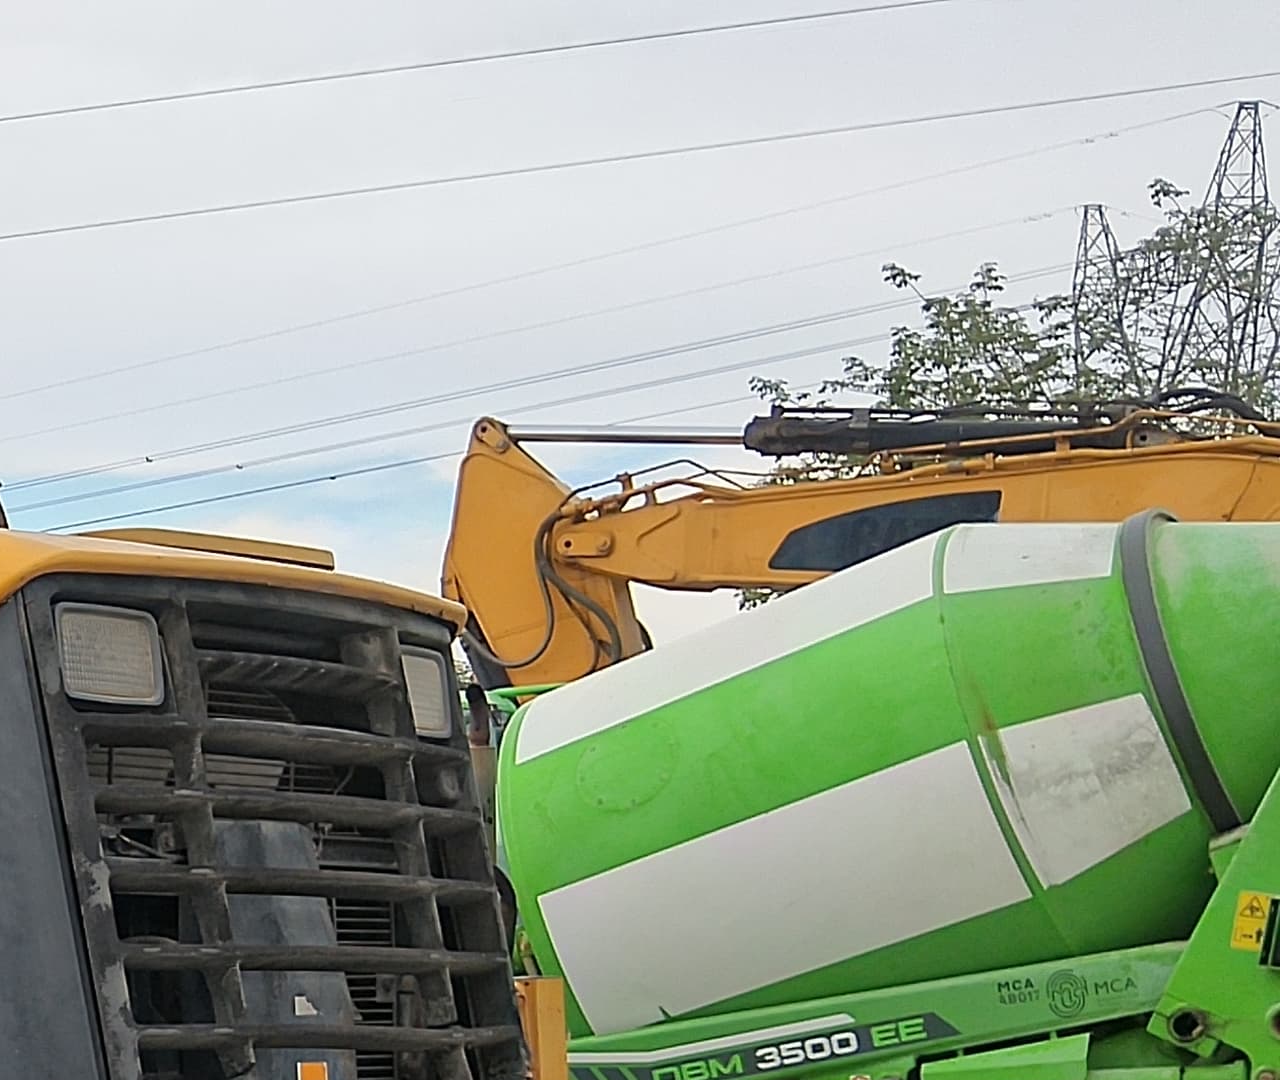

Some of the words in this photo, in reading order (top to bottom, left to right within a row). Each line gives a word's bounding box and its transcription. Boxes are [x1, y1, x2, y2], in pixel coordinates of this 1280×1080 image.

[997, 978, 1035, 993] MCA
[1094, 977, 1137, 995] MCA
[755, 1031, 859, 1070] 3500
[871, 1017, 928, 1048] EE
